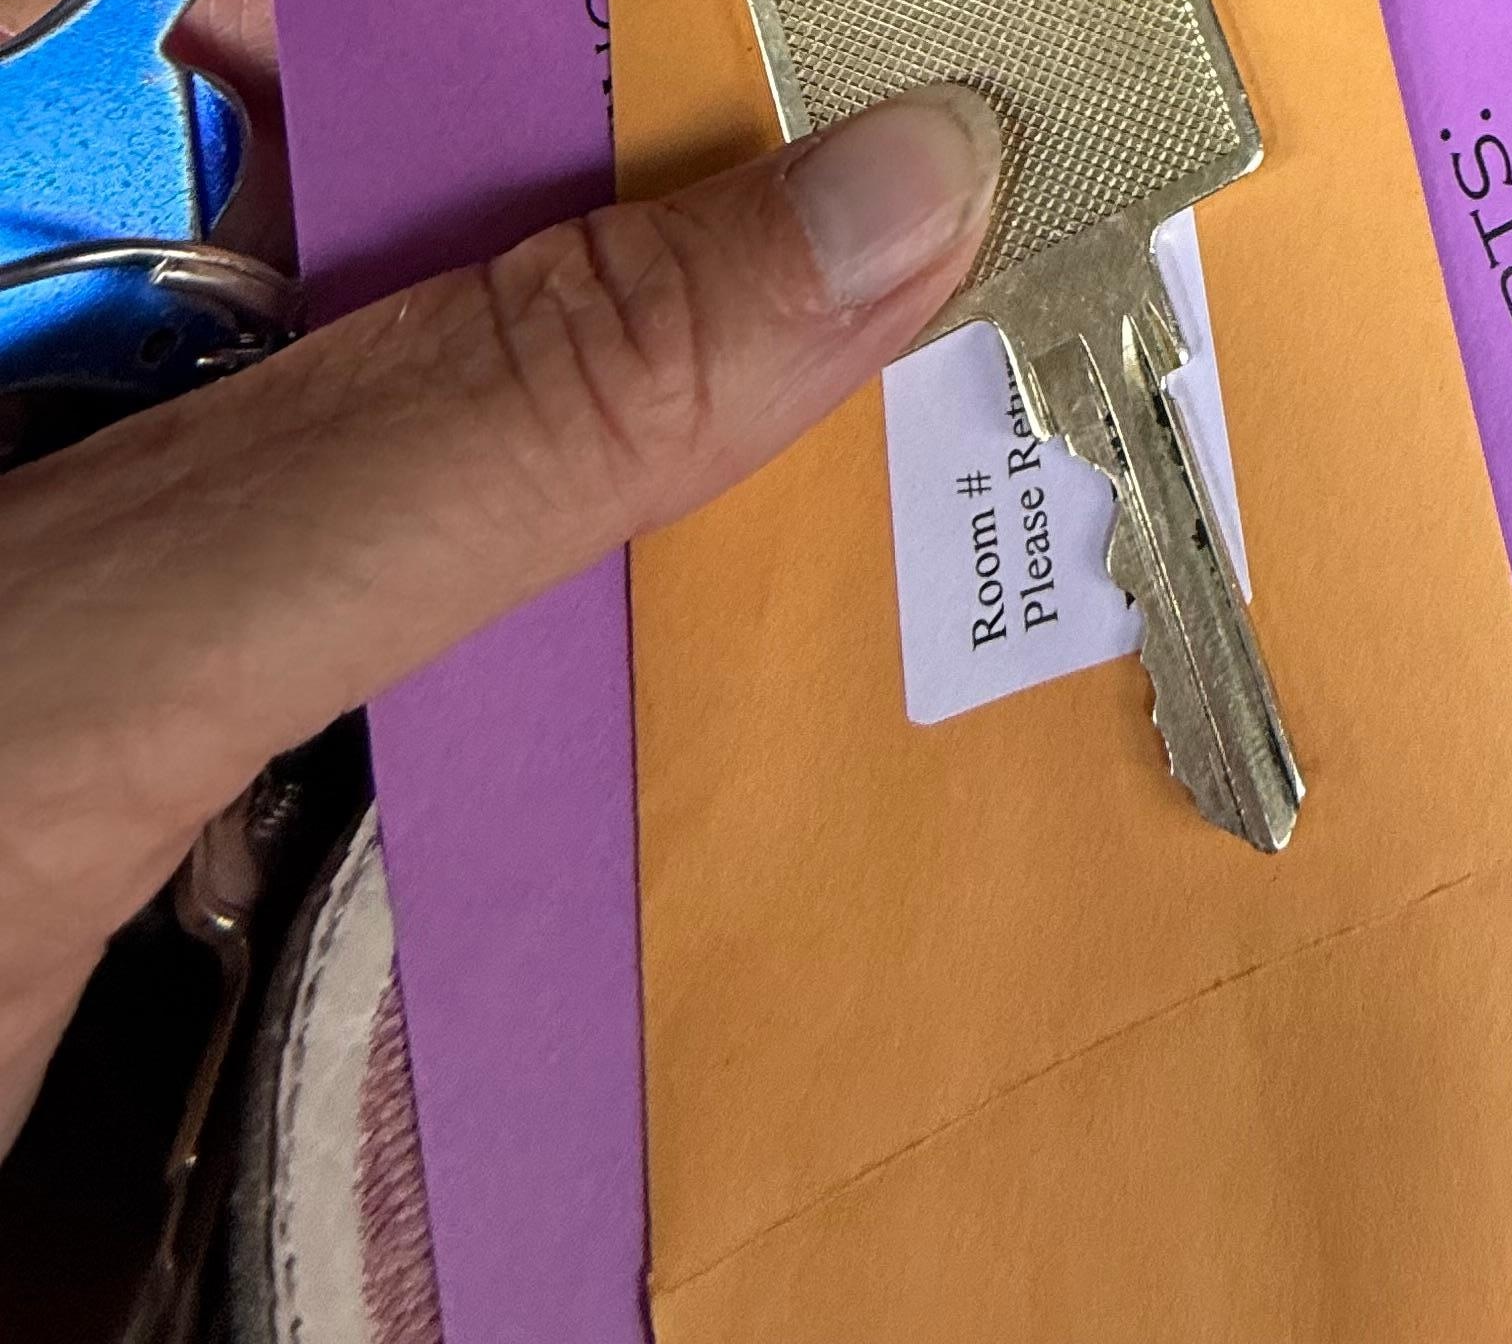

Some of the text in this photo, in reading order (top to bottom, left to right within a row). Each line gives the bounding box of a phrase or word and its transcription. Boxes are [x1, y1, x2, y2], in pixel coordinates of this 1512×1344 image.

[955, 469, 1008, 652] Room #
[1019, 485, 1059, 633] Please
